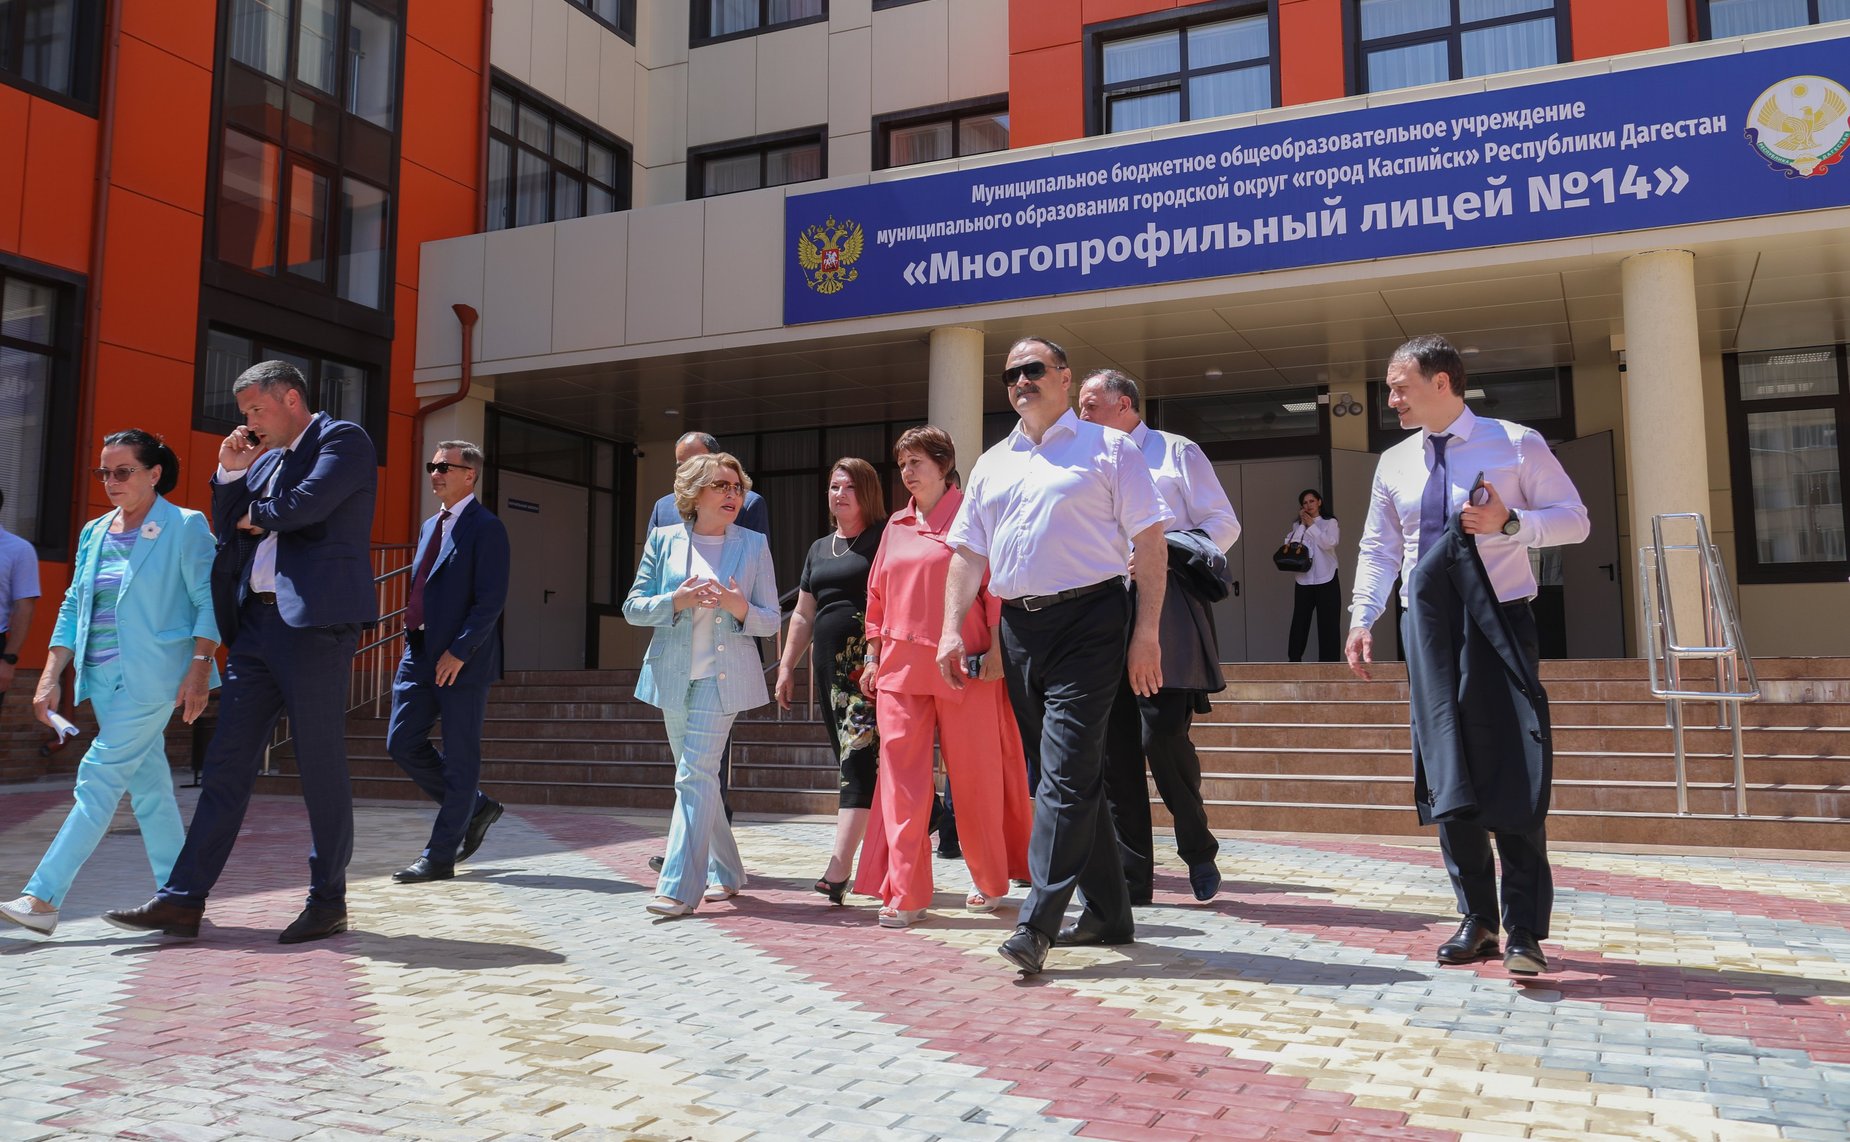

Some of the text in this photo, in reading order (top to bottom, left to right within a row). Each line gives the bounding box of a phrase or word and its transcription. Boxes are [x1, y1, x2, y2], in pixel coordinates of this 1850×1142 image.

[876, 114, 1727, 246] муниципального образования городской округ «город Каспийск» Республики Дагестан
[972, 101, 1587, 205] Муниципальное бюджетное общеобразовательное учреждение
[902, 163, 1690, 287] «Многопрофильный лицей №14»
